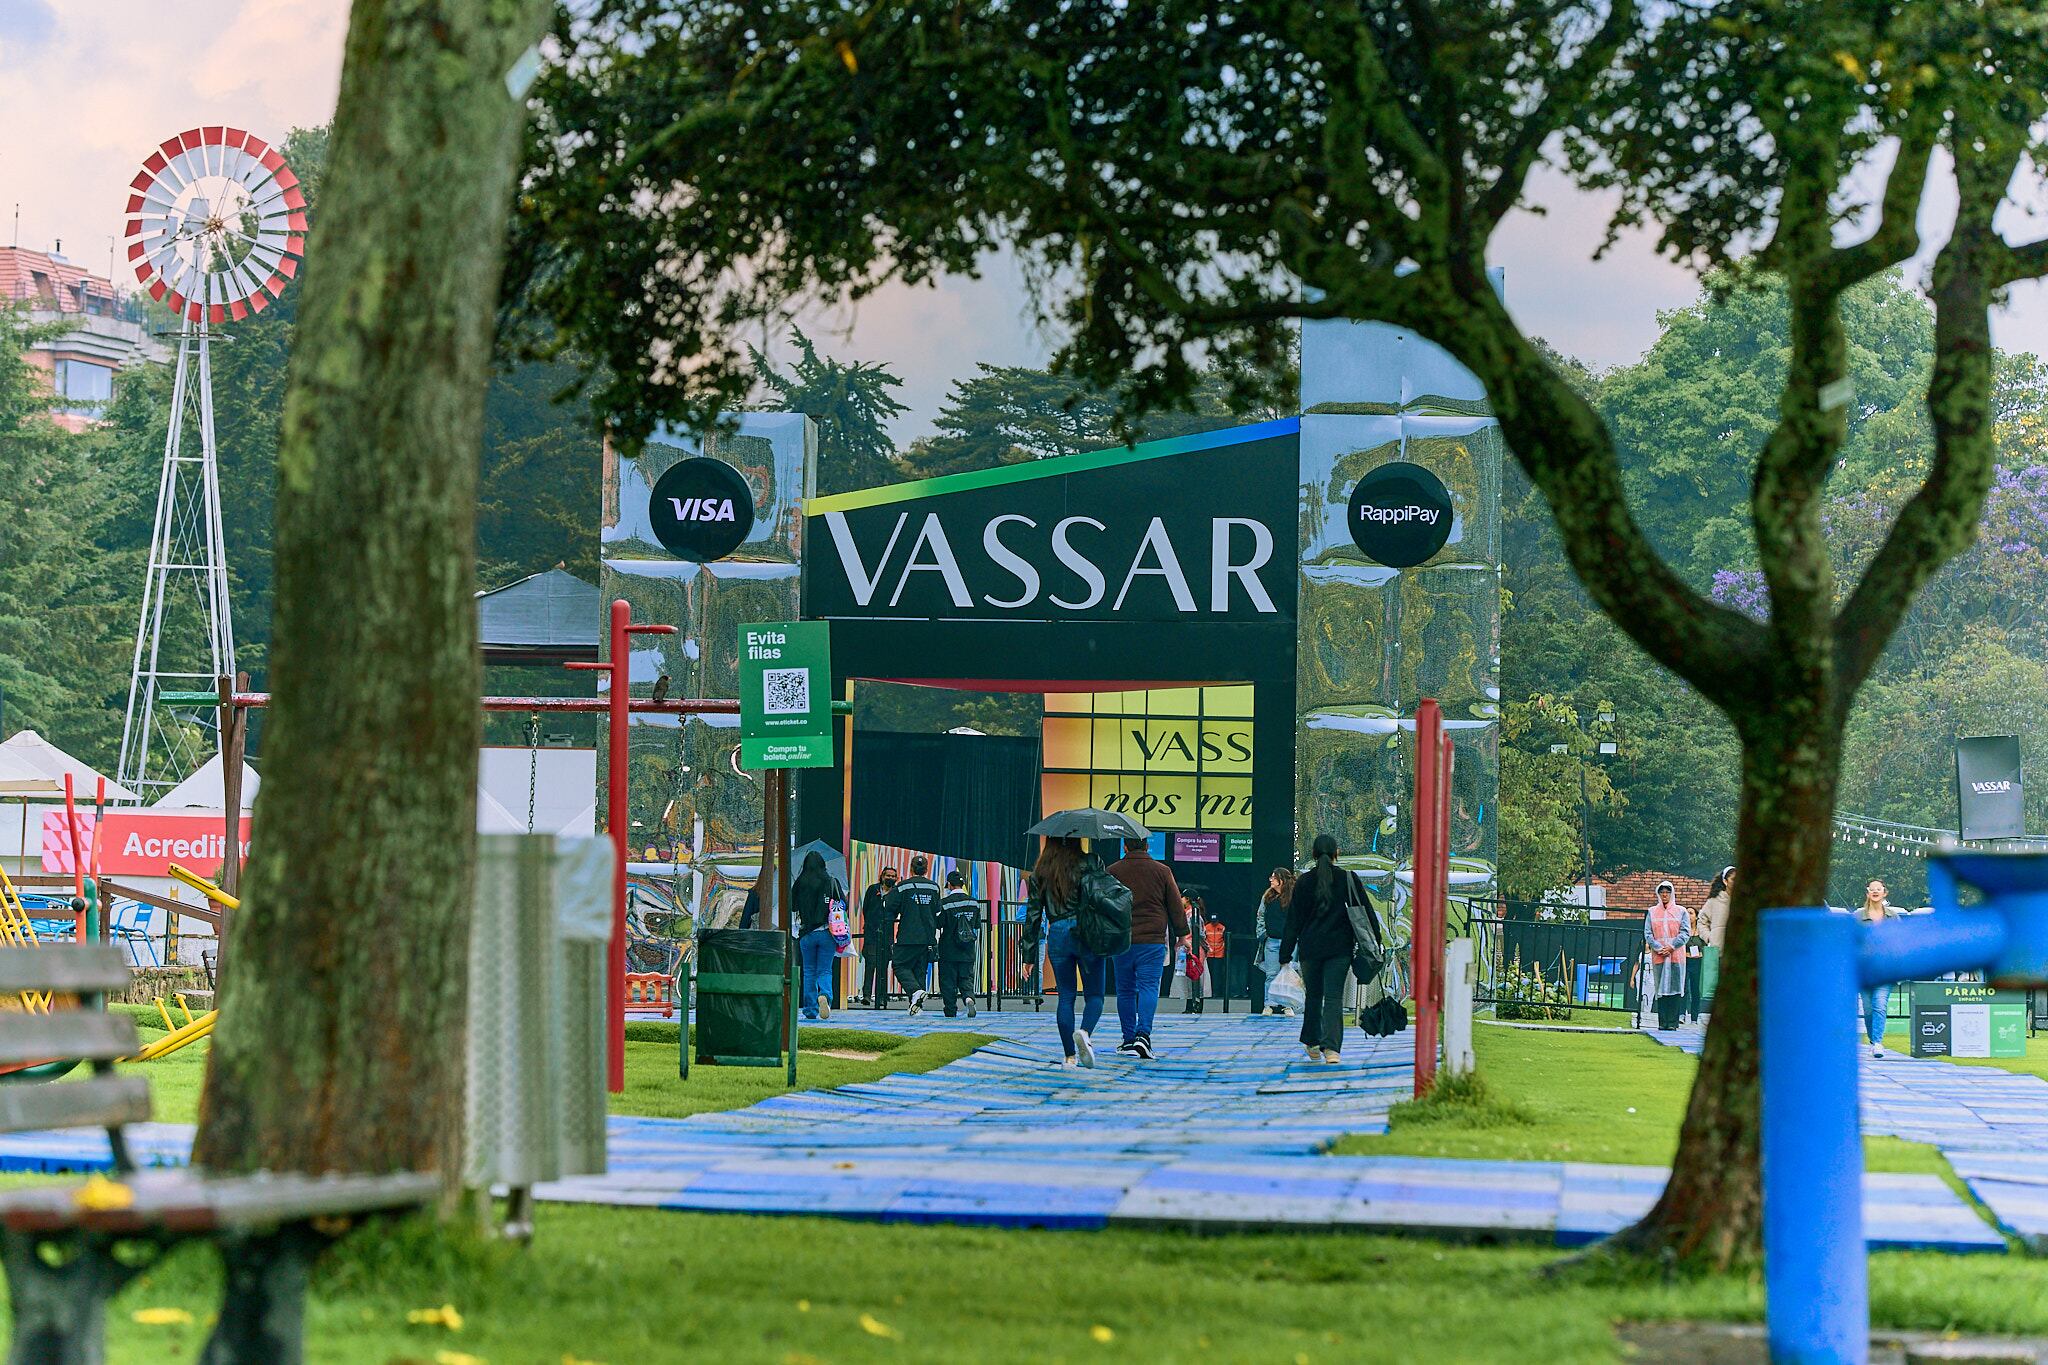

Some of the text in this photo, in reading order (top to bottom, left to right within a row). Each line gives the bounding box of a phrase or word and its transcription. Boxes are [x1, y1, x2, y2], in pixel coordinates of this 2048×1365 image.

[667, 498, 735, 521] VISA
[1360, 505, 1440, 525] RappiPay
[824, 512, 1277, 612] VASSAR
[747, 631, 785, 645] Evita
[748, 646, 781, 660] filas
[1132, 731, 1251, 762] VASS
[1972, 781, 2010, 791] VASSAR
[1104, 793, 1181, 815] nos
[123, 832, 252, 858] Acredit
[1945, 986, 1996, 996] PÁRAMO
